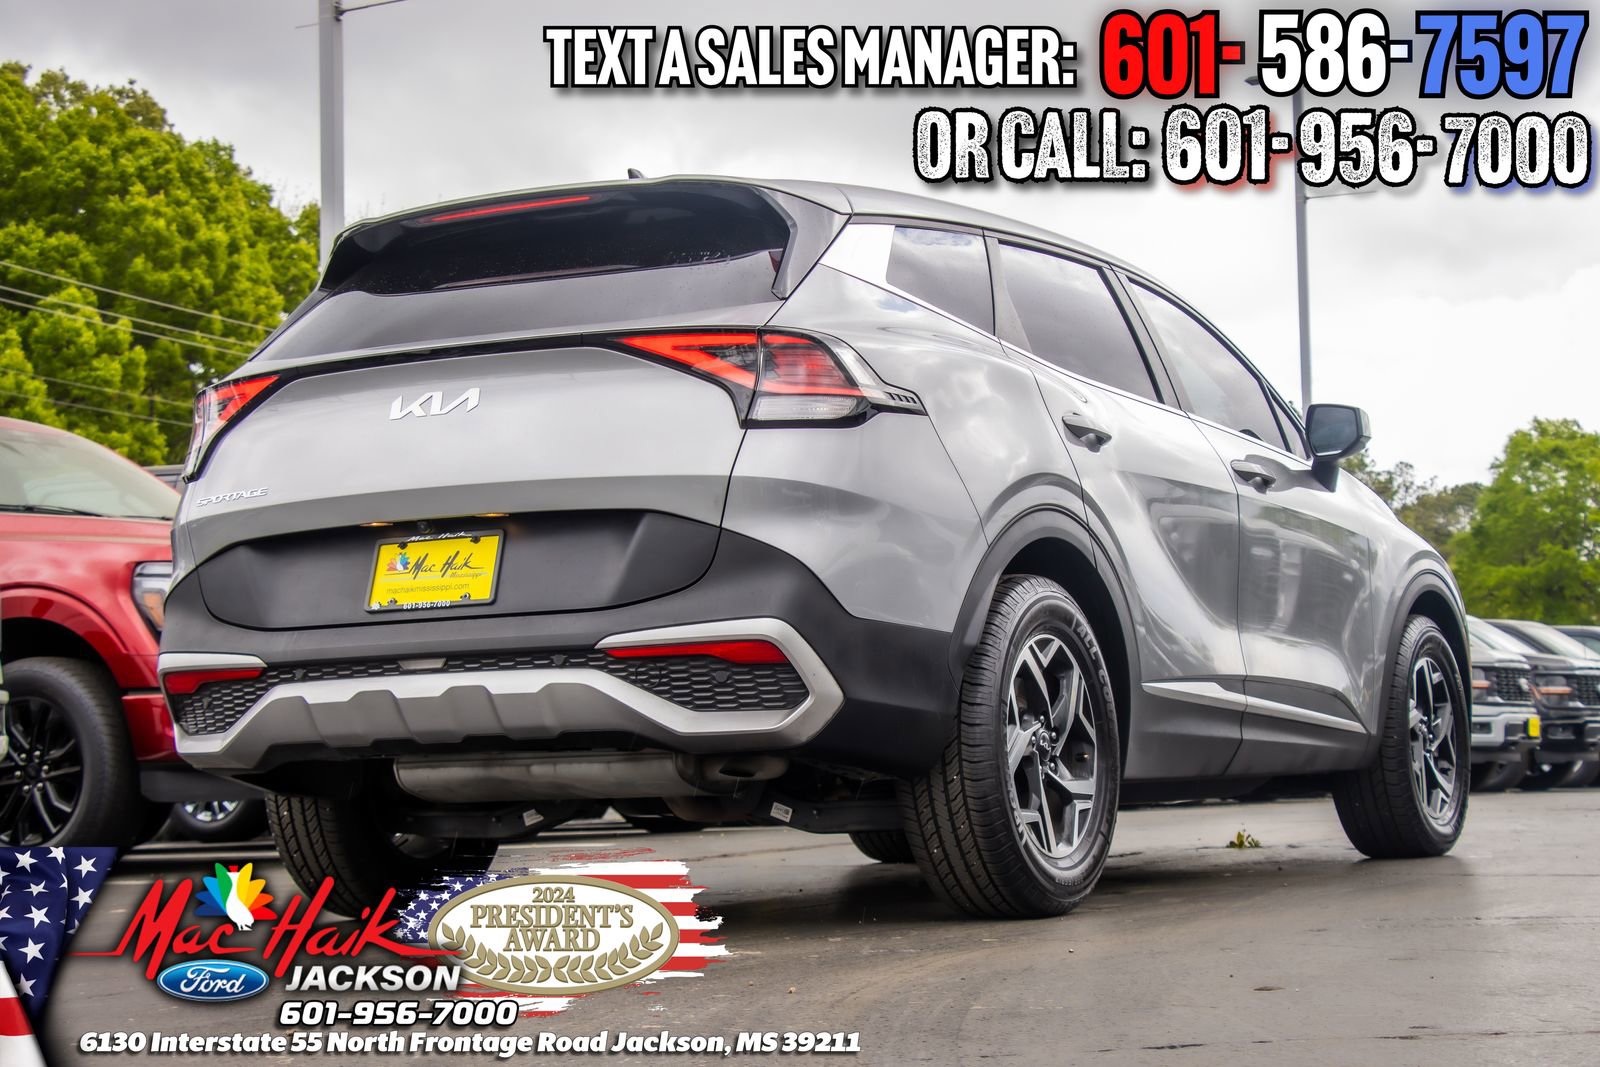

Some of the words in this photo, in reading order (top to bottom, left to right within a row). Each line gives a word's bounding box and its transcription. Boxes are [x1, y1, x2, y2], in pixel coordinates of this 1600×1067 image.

[389, 387, 480, 420] KIA
[196, 487, 269, 507] SPORTAGE
[408, 552, 436, 580] Mac
[440, 550, 484, 578] Haik
[1077, 625, 1098, 660] ALL
